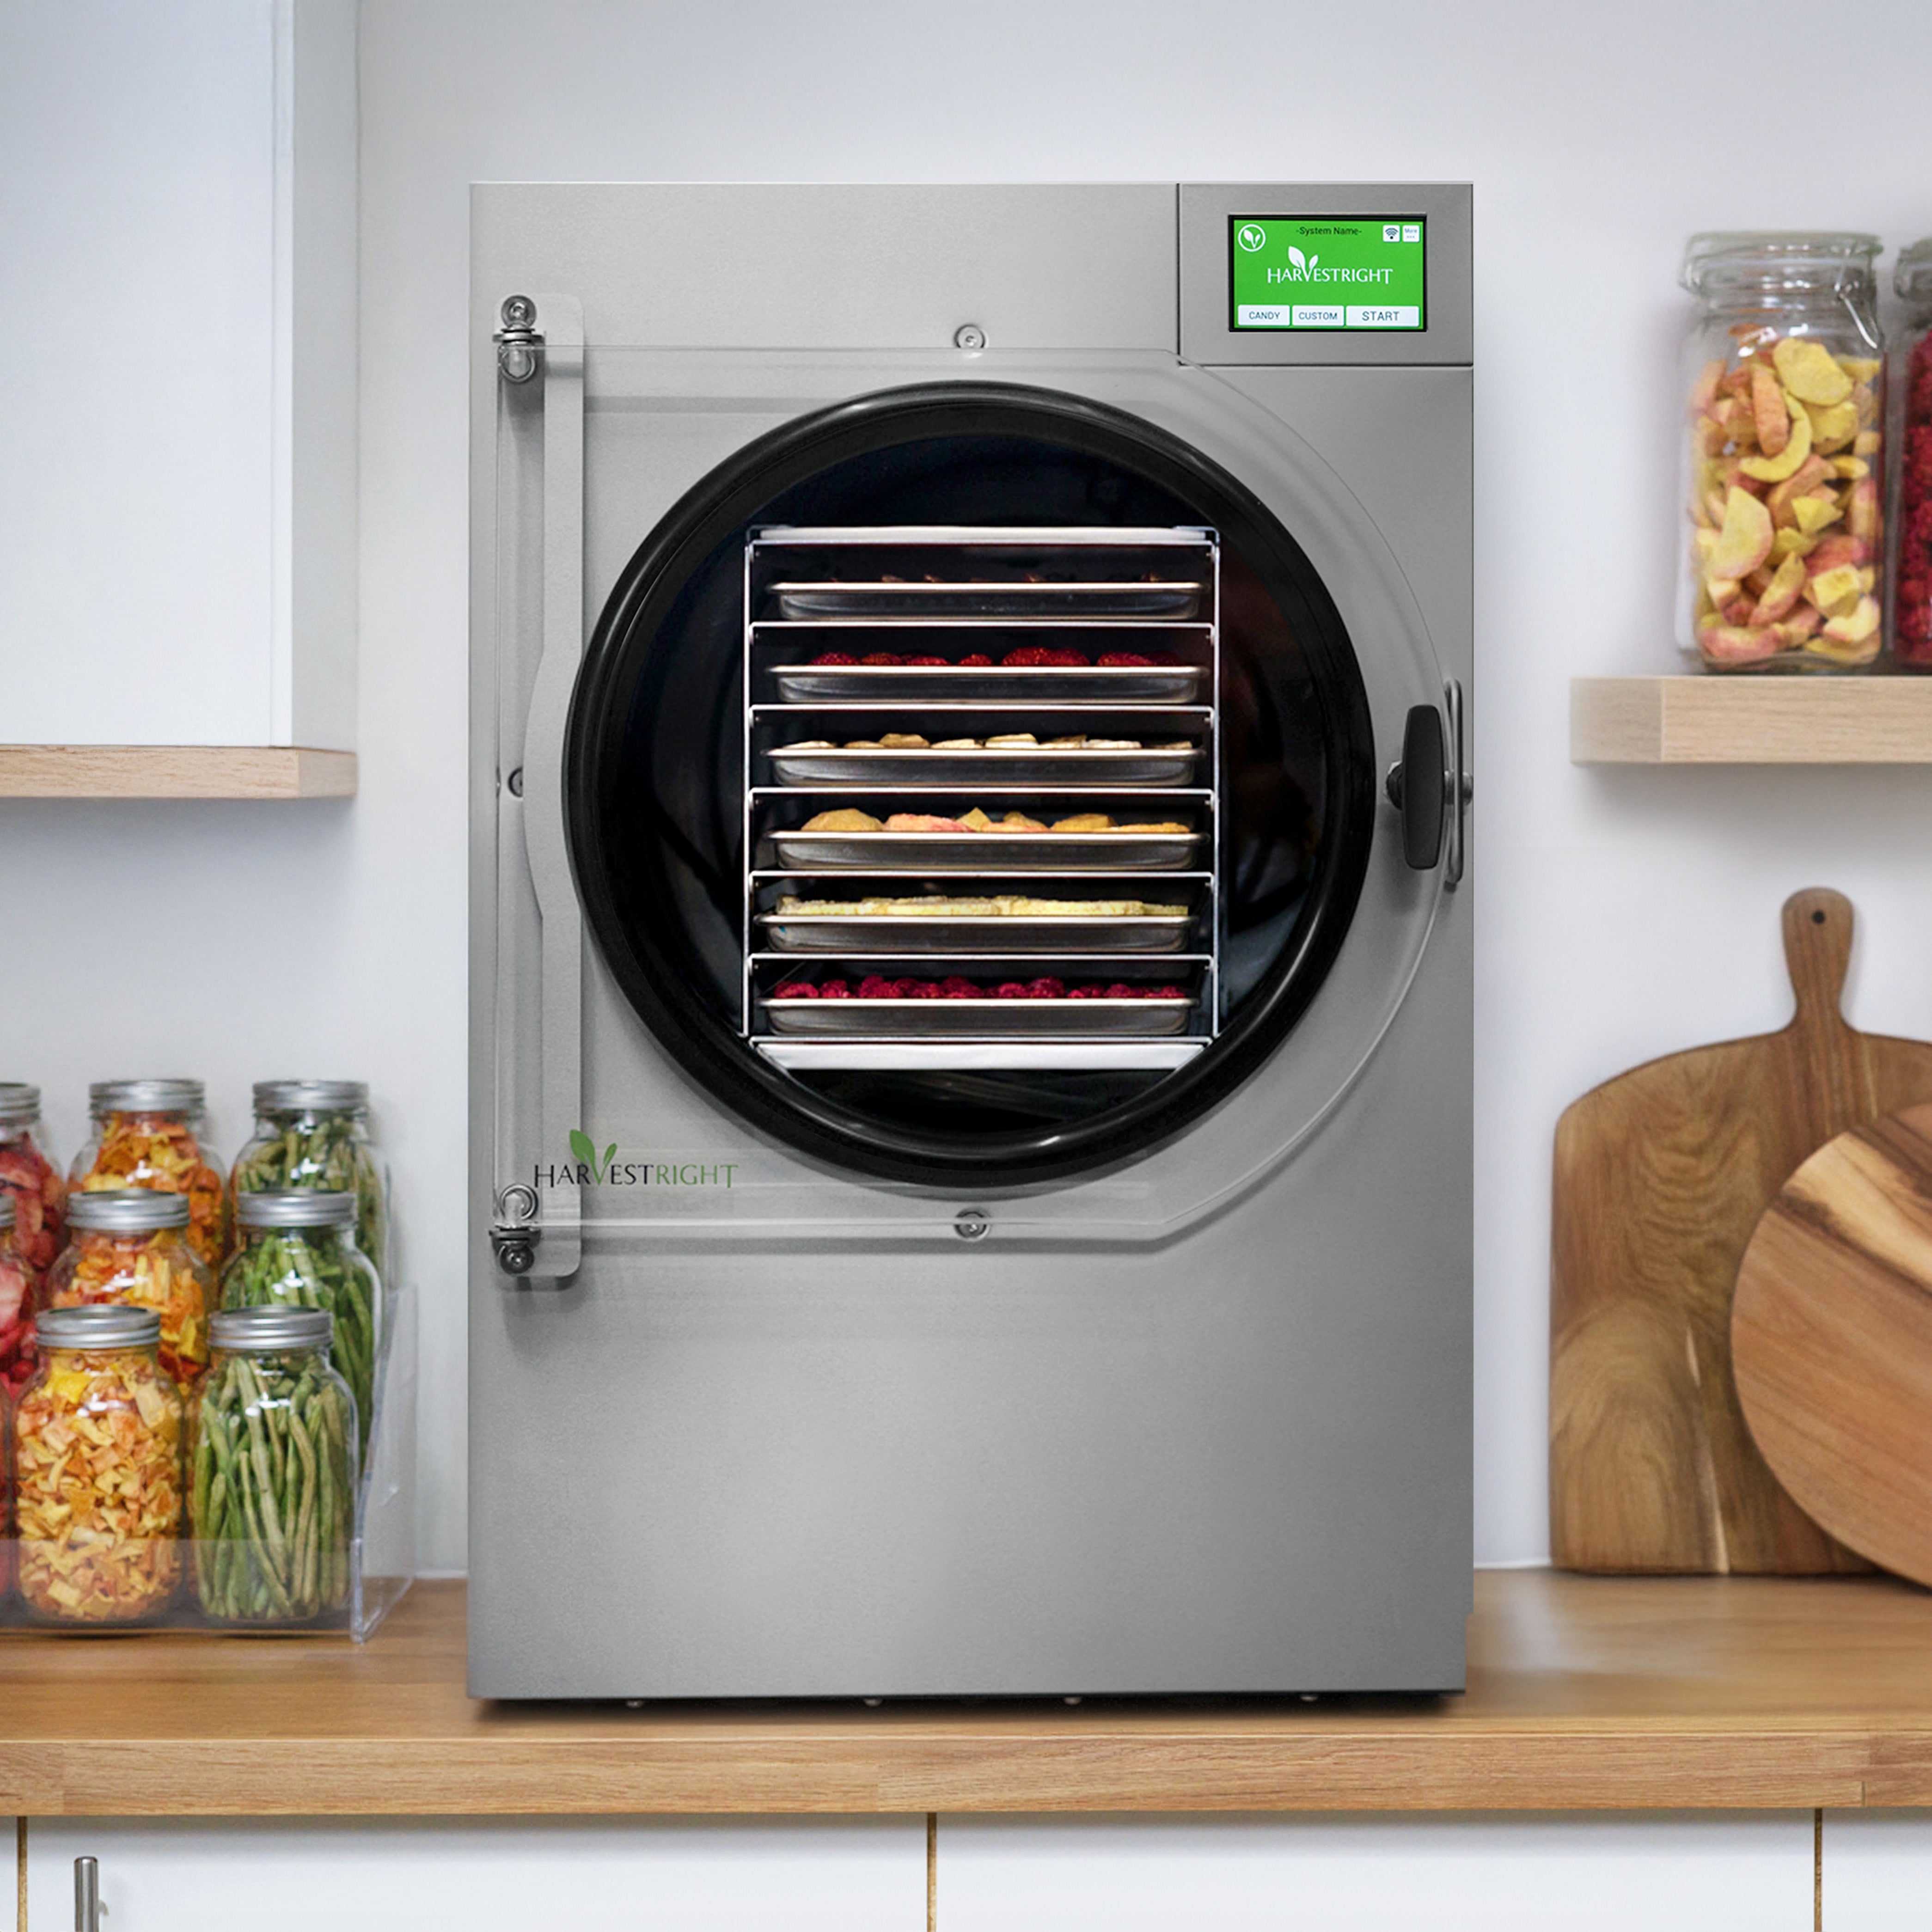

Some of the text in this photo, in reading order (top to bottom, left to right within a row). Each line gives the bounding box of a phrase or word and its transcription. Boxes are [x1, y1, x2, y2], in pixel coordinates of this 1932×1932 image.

[1249, 311, 1280, 320] CANDY
[1298, 312, 1338, 320] CUSTOM
[1362, 311, 1400, 321] START
